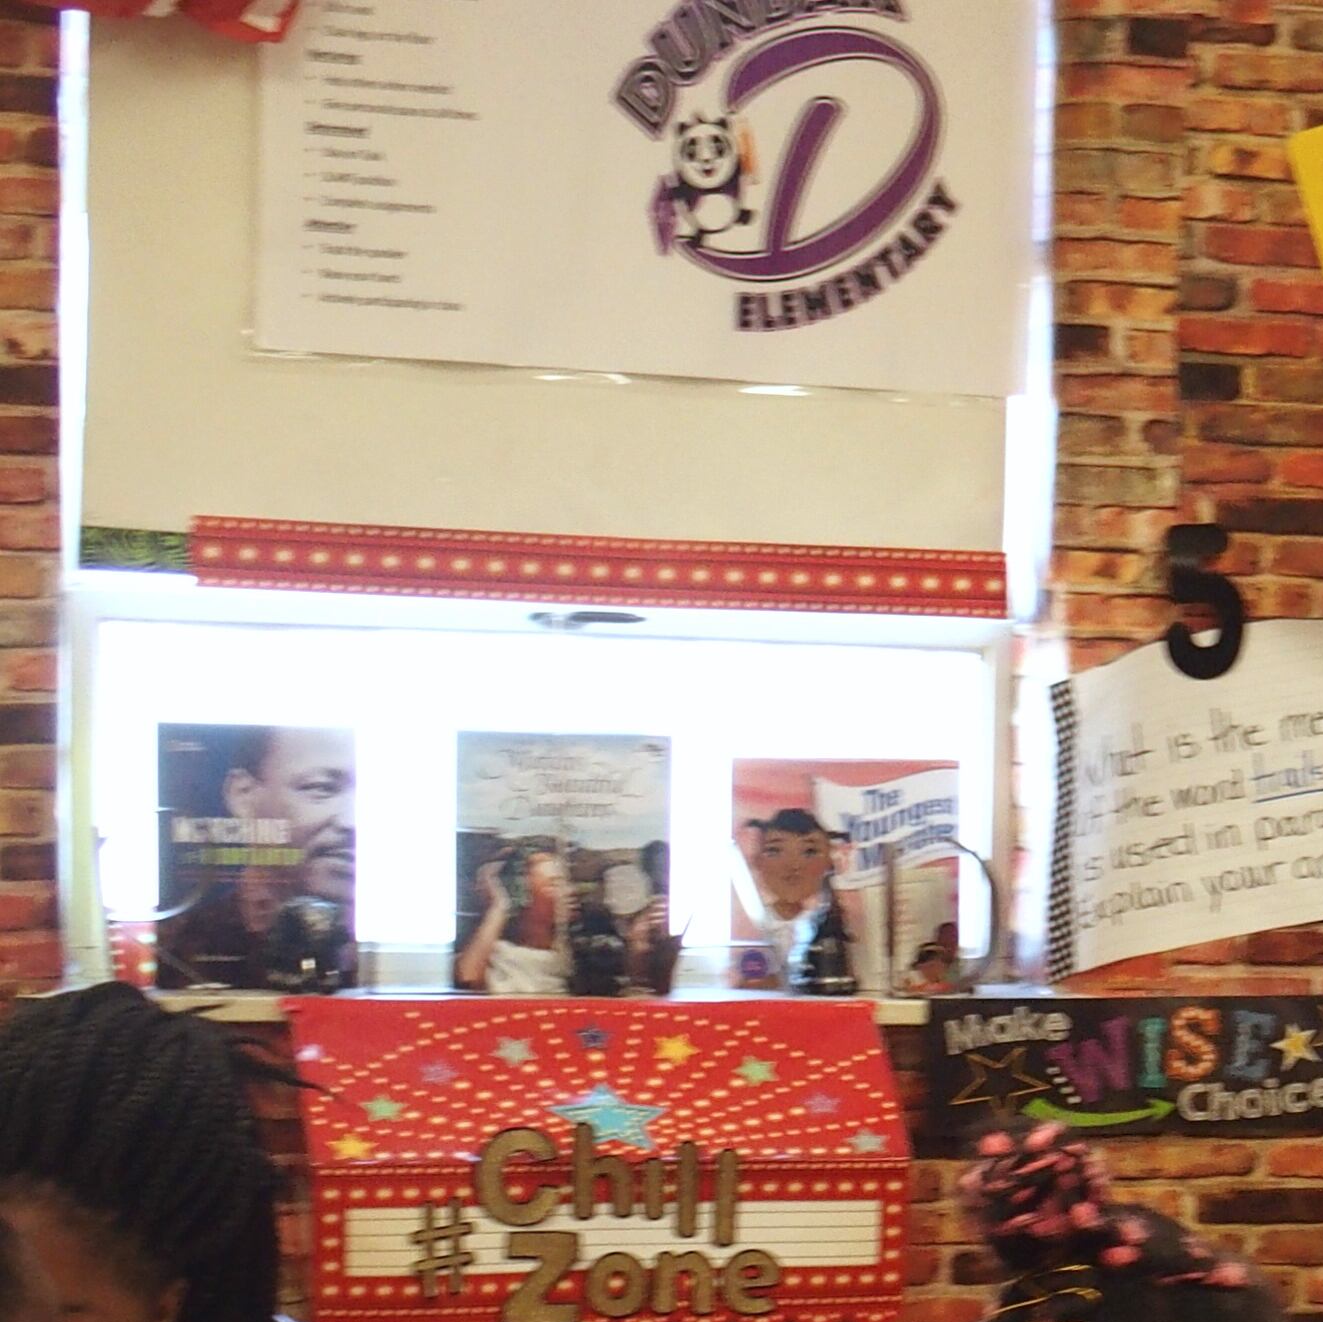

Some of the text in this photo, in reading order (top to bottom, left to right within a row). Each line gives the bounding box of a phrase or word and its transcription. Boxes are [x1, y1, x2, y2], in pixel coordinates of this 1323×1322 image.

[734, 179, 962, 332] ELEMENTARY
[1166, 732, 1199, 762] is
[1208, 708, 1268, 748] the
[862, 789, 901, 807] The
[1170, 770, 1245, 810] word
[1108, 825, 1195, 871] used
[1206, 818, 1242, 849] in
[1199, 858, 1283, 910] your
[942, 1005, 1073, 1056] Make
[1046, 1004, 1276, 1102] WISE
[476, 1122, 738, 1246] Chill
